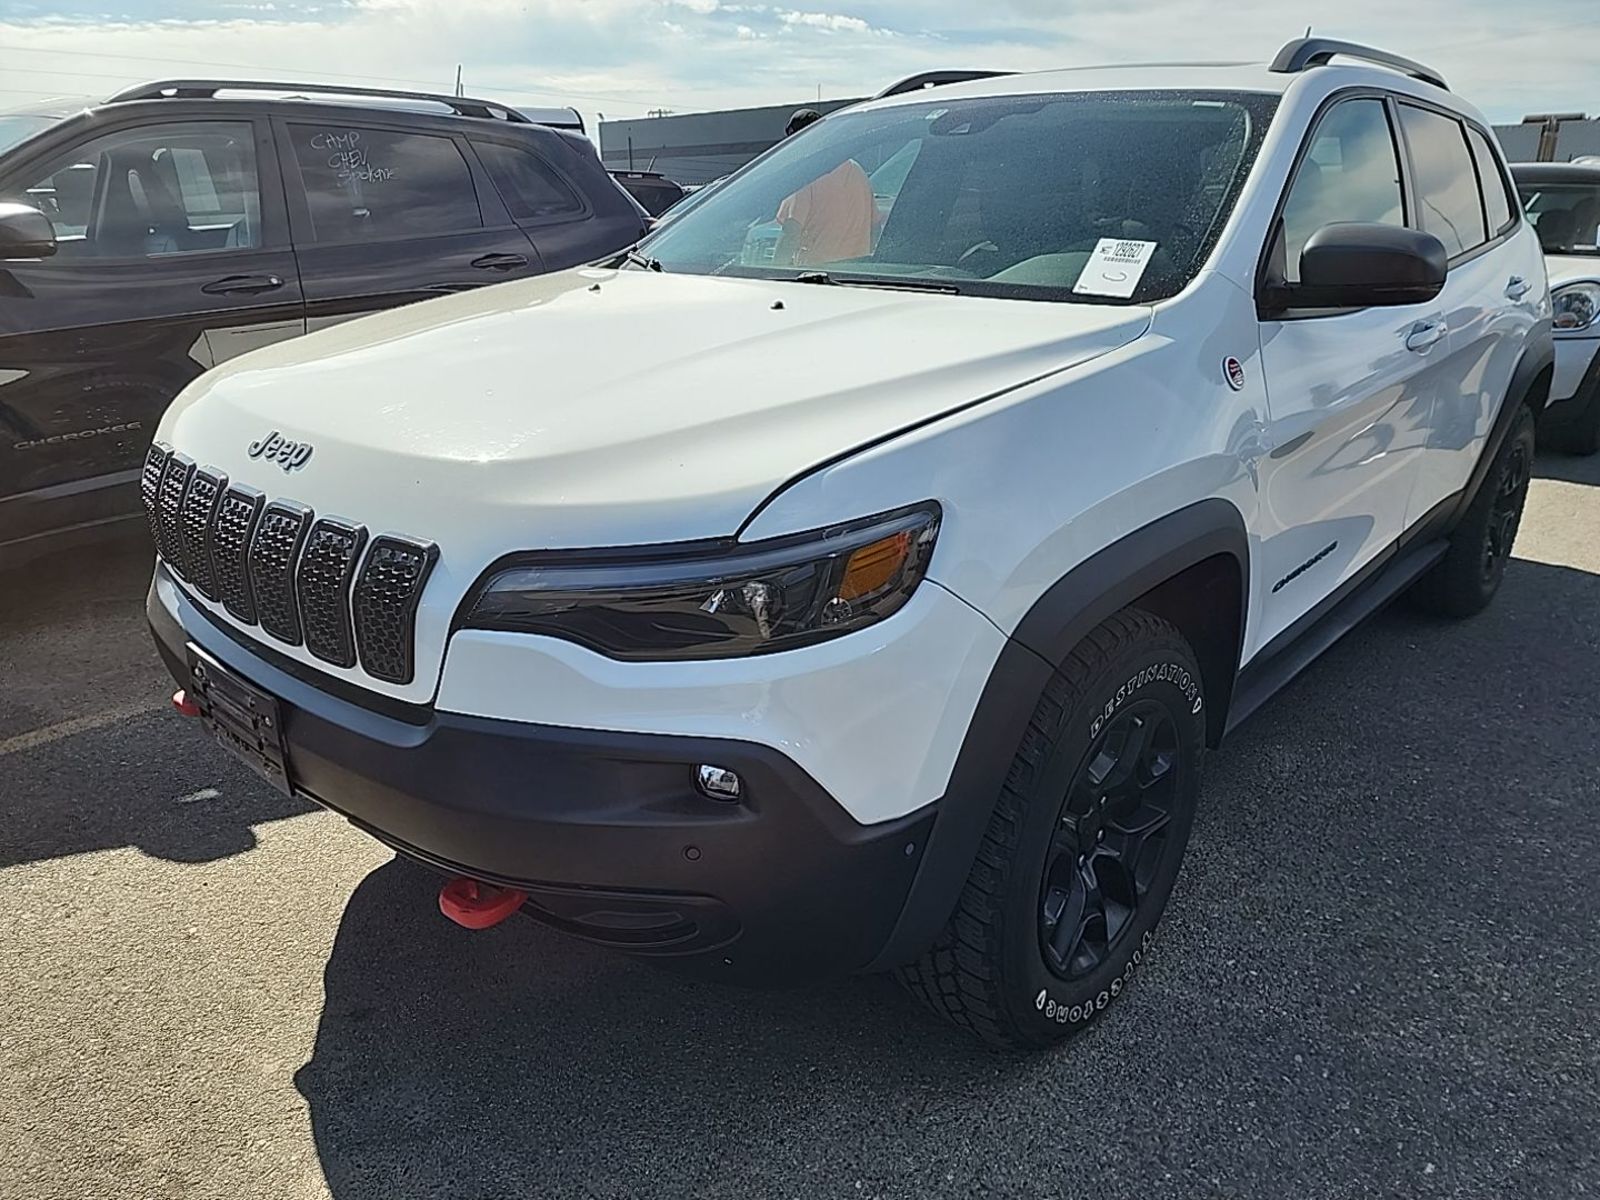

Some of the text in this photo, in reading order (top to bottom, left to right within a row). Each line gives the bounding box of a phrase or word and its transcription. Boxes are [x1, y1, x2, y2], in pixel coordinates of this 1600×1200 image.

[310, 131, 360, 150] CAMP
[13, 421, 142, 450] CHEROKEE
[249, 430, 314, 473] Jeep
[1090, 663, 1199, 740] DESTINATION
